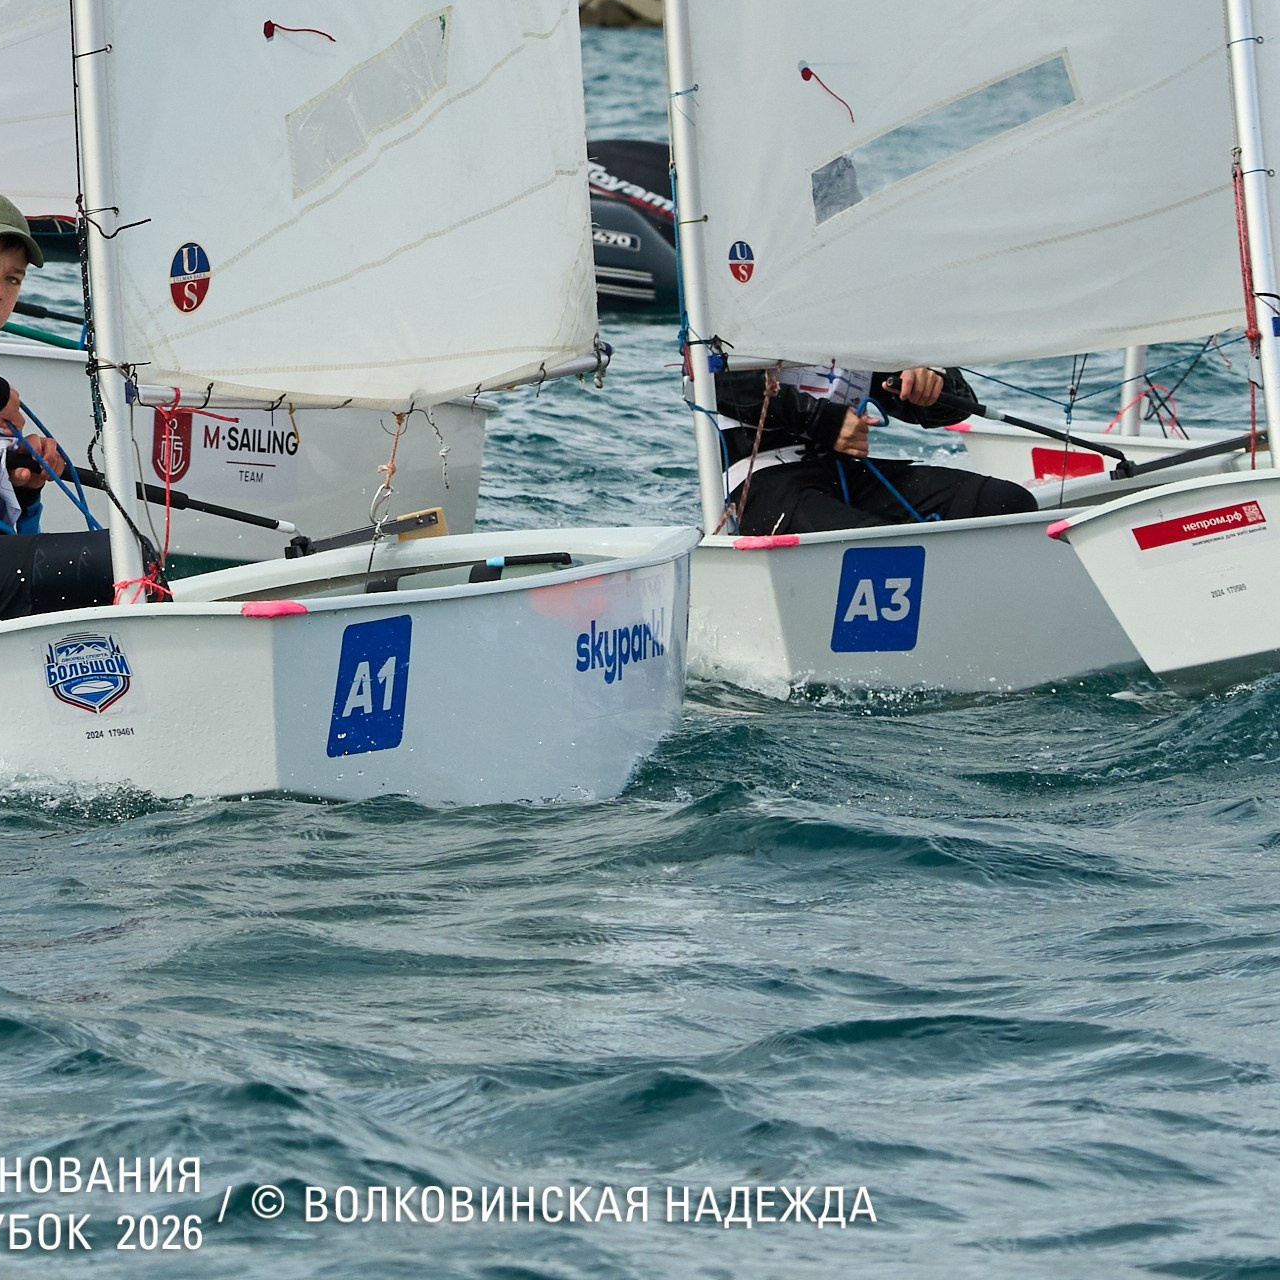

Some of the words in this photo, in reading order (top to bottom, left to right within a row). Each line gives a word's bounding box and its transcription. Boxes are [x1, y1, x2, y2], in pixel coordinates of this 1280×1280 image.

[181, 246, 200, 274] U
[735, 243, 747, 260] U
[738, 264, 748, 282] S
[183, 281, 198, 311] S
[239, 470, 263, 483] TEAM
[1182, 510, 1243, 532] непром.рф
[843, 577, 912, 622] A3
[46, 652, 131, 686] БОЛЬШОЙ
[342, 656, 396, 718] A1
[86, 730, 104, 739] 2024
[108, 727, 135, 737] 179461
